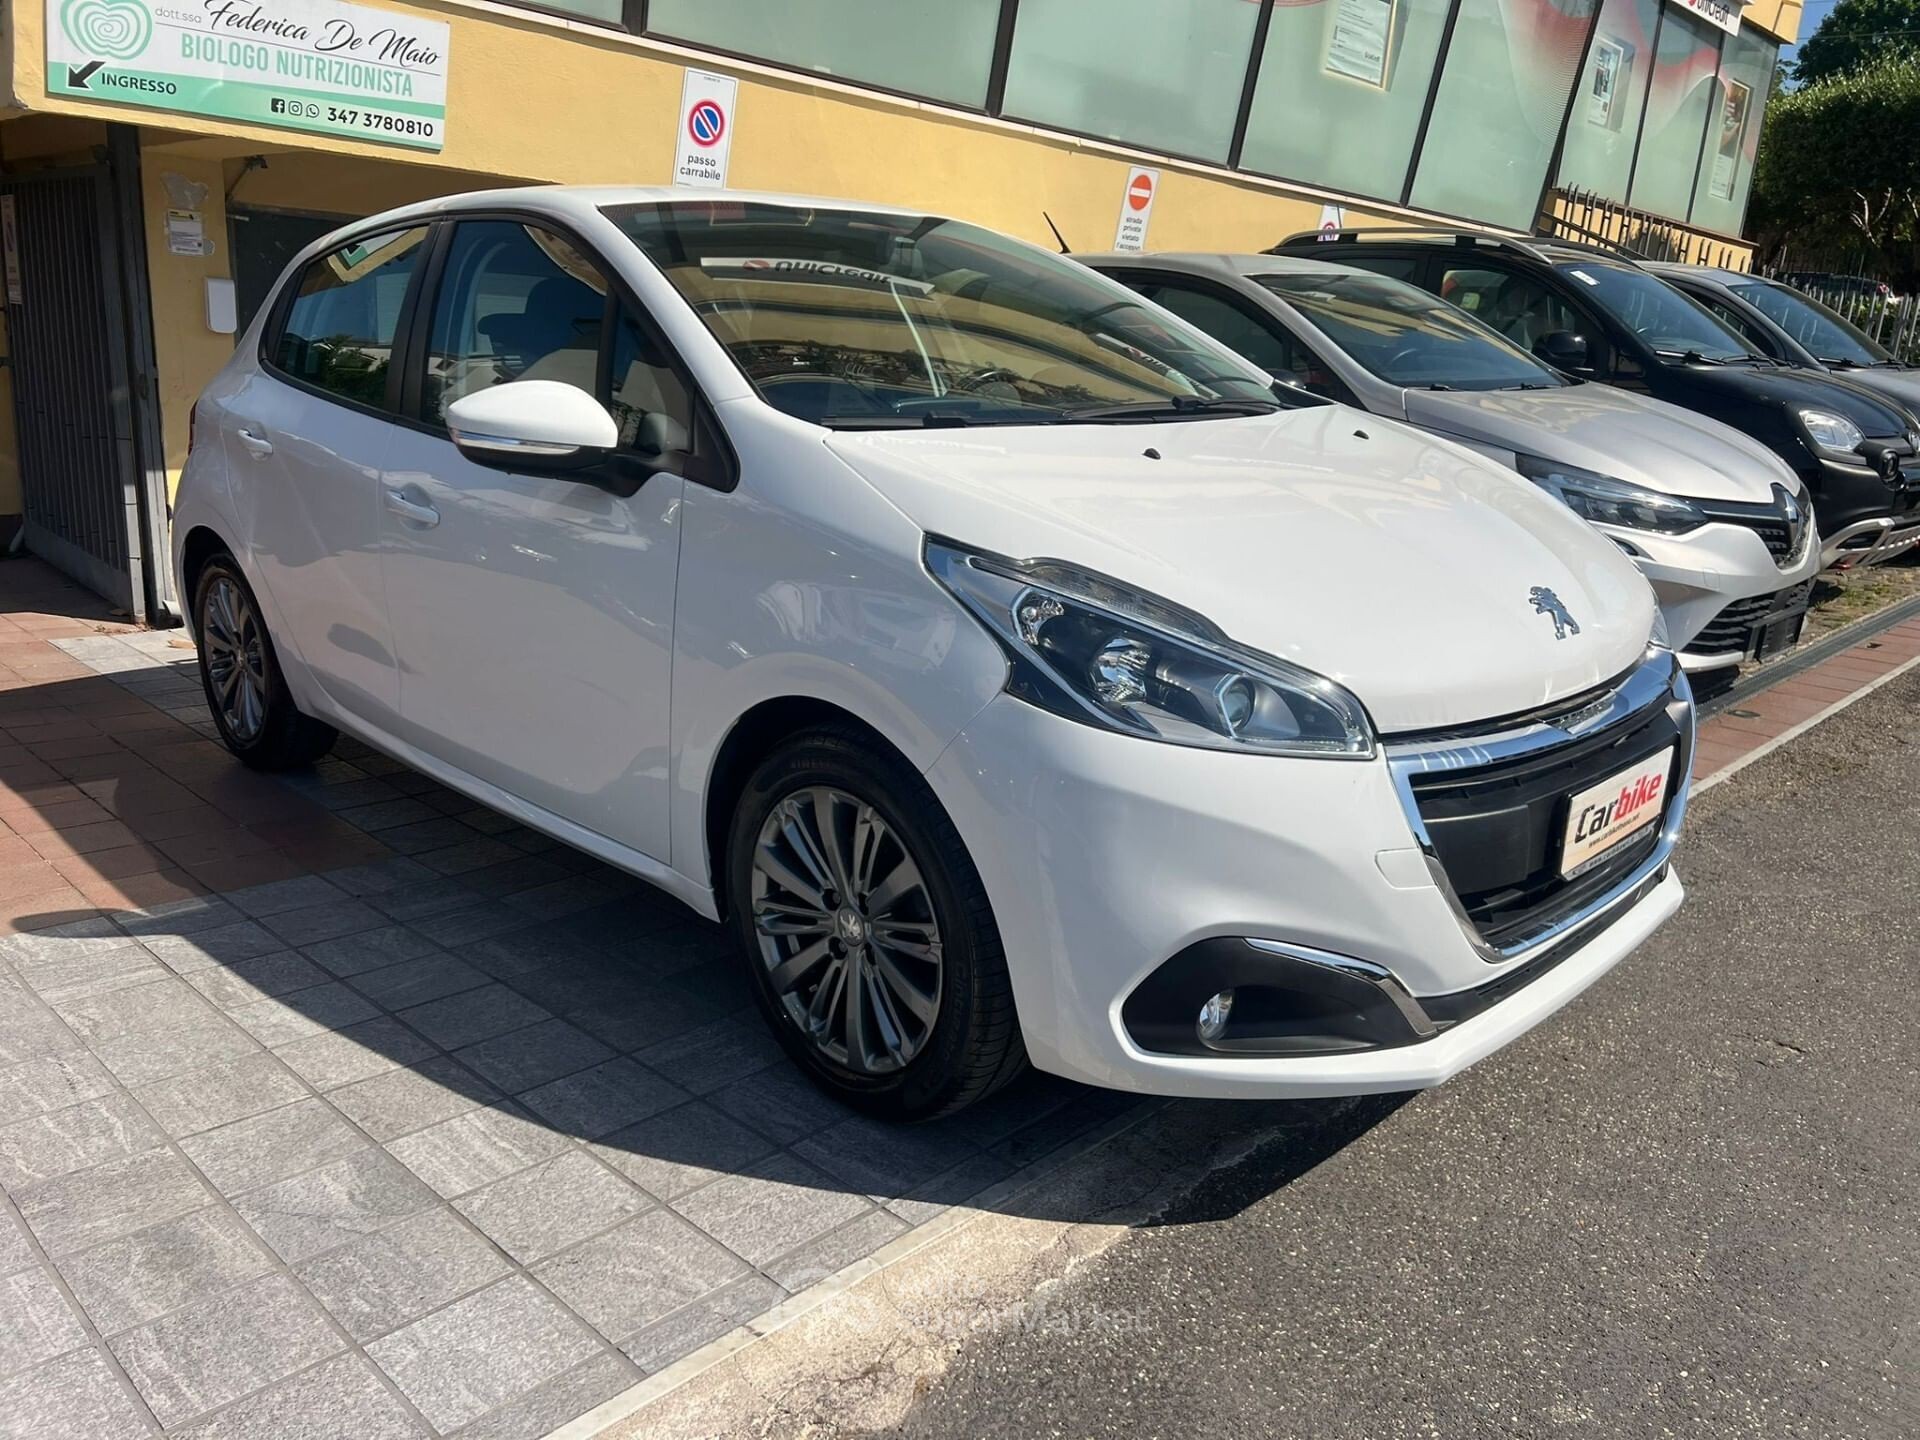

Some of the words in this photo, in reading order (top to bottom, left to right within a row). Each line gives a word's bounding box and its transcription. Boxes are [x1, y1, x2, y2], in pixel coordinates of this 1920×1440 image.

[155, 6, 202, 24] dott.ssa
[204, 0, 311, 41] Federica
[315, 19, 363, 51] De
[369, 28, 441, 68] Maio
[181, 33, 269, 72] BIOLOGO
[276, 54, 413, 97] NUTRIZIONISTA
[101, 72, 178, 95] INGRESSO
[328, 106, 359, 126] 347
[363, 112, 434, 138] 3780810
[680, 166, 721, 181] carrabile
[687, 154, 717, 168] passo
[1574, 774, 1662, 844] Carbike
